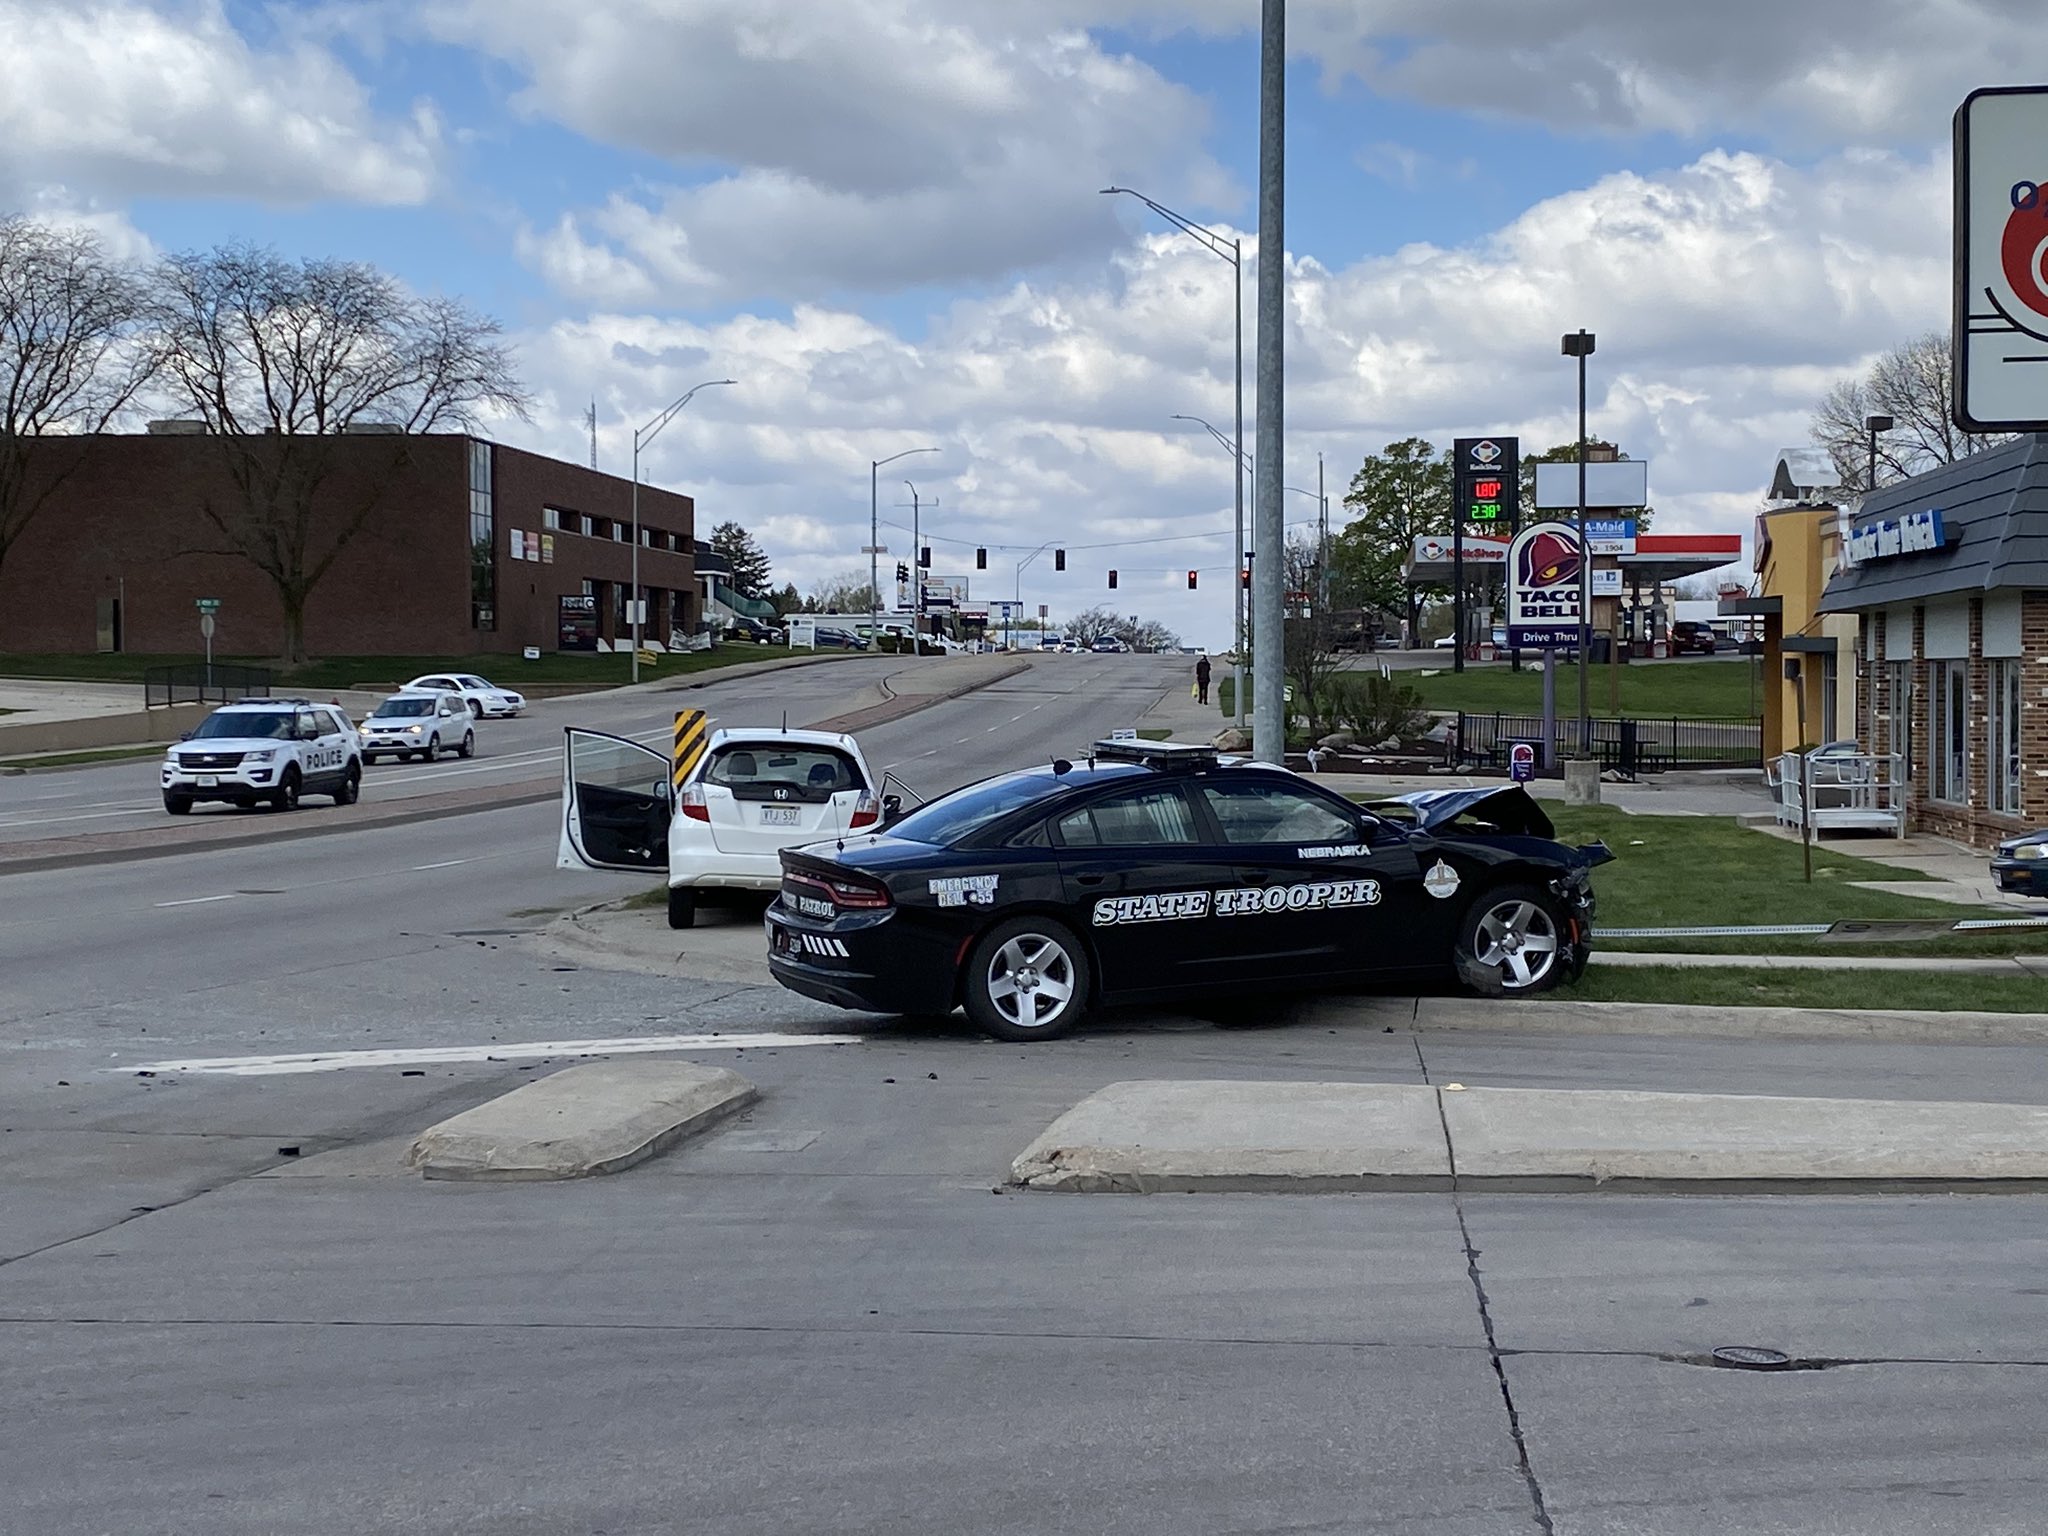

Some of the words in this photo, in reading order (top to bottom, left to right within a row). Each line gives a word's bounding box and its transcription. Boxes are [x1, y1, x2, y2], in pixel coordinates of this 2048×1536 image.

[1446, 547, 1504, 560] KikShop
[1516, 590, 1580, 603] TACO
[1520, 605, 1580, 617] BELL
[1523, 632, 1550, 642] Drive
[1554, 632, 1578, 641] Thru
[306, 749, 343, 770] POLICE
[1298, 844, 1371, 858] NEBRASKA
[928, 874, 999, 894] EMERGENCY
[800, 896, 835, 918] PATROL
[1092, 890, 1212, 926] STATE
[1215, 879, 1382, 917] TROOPER
